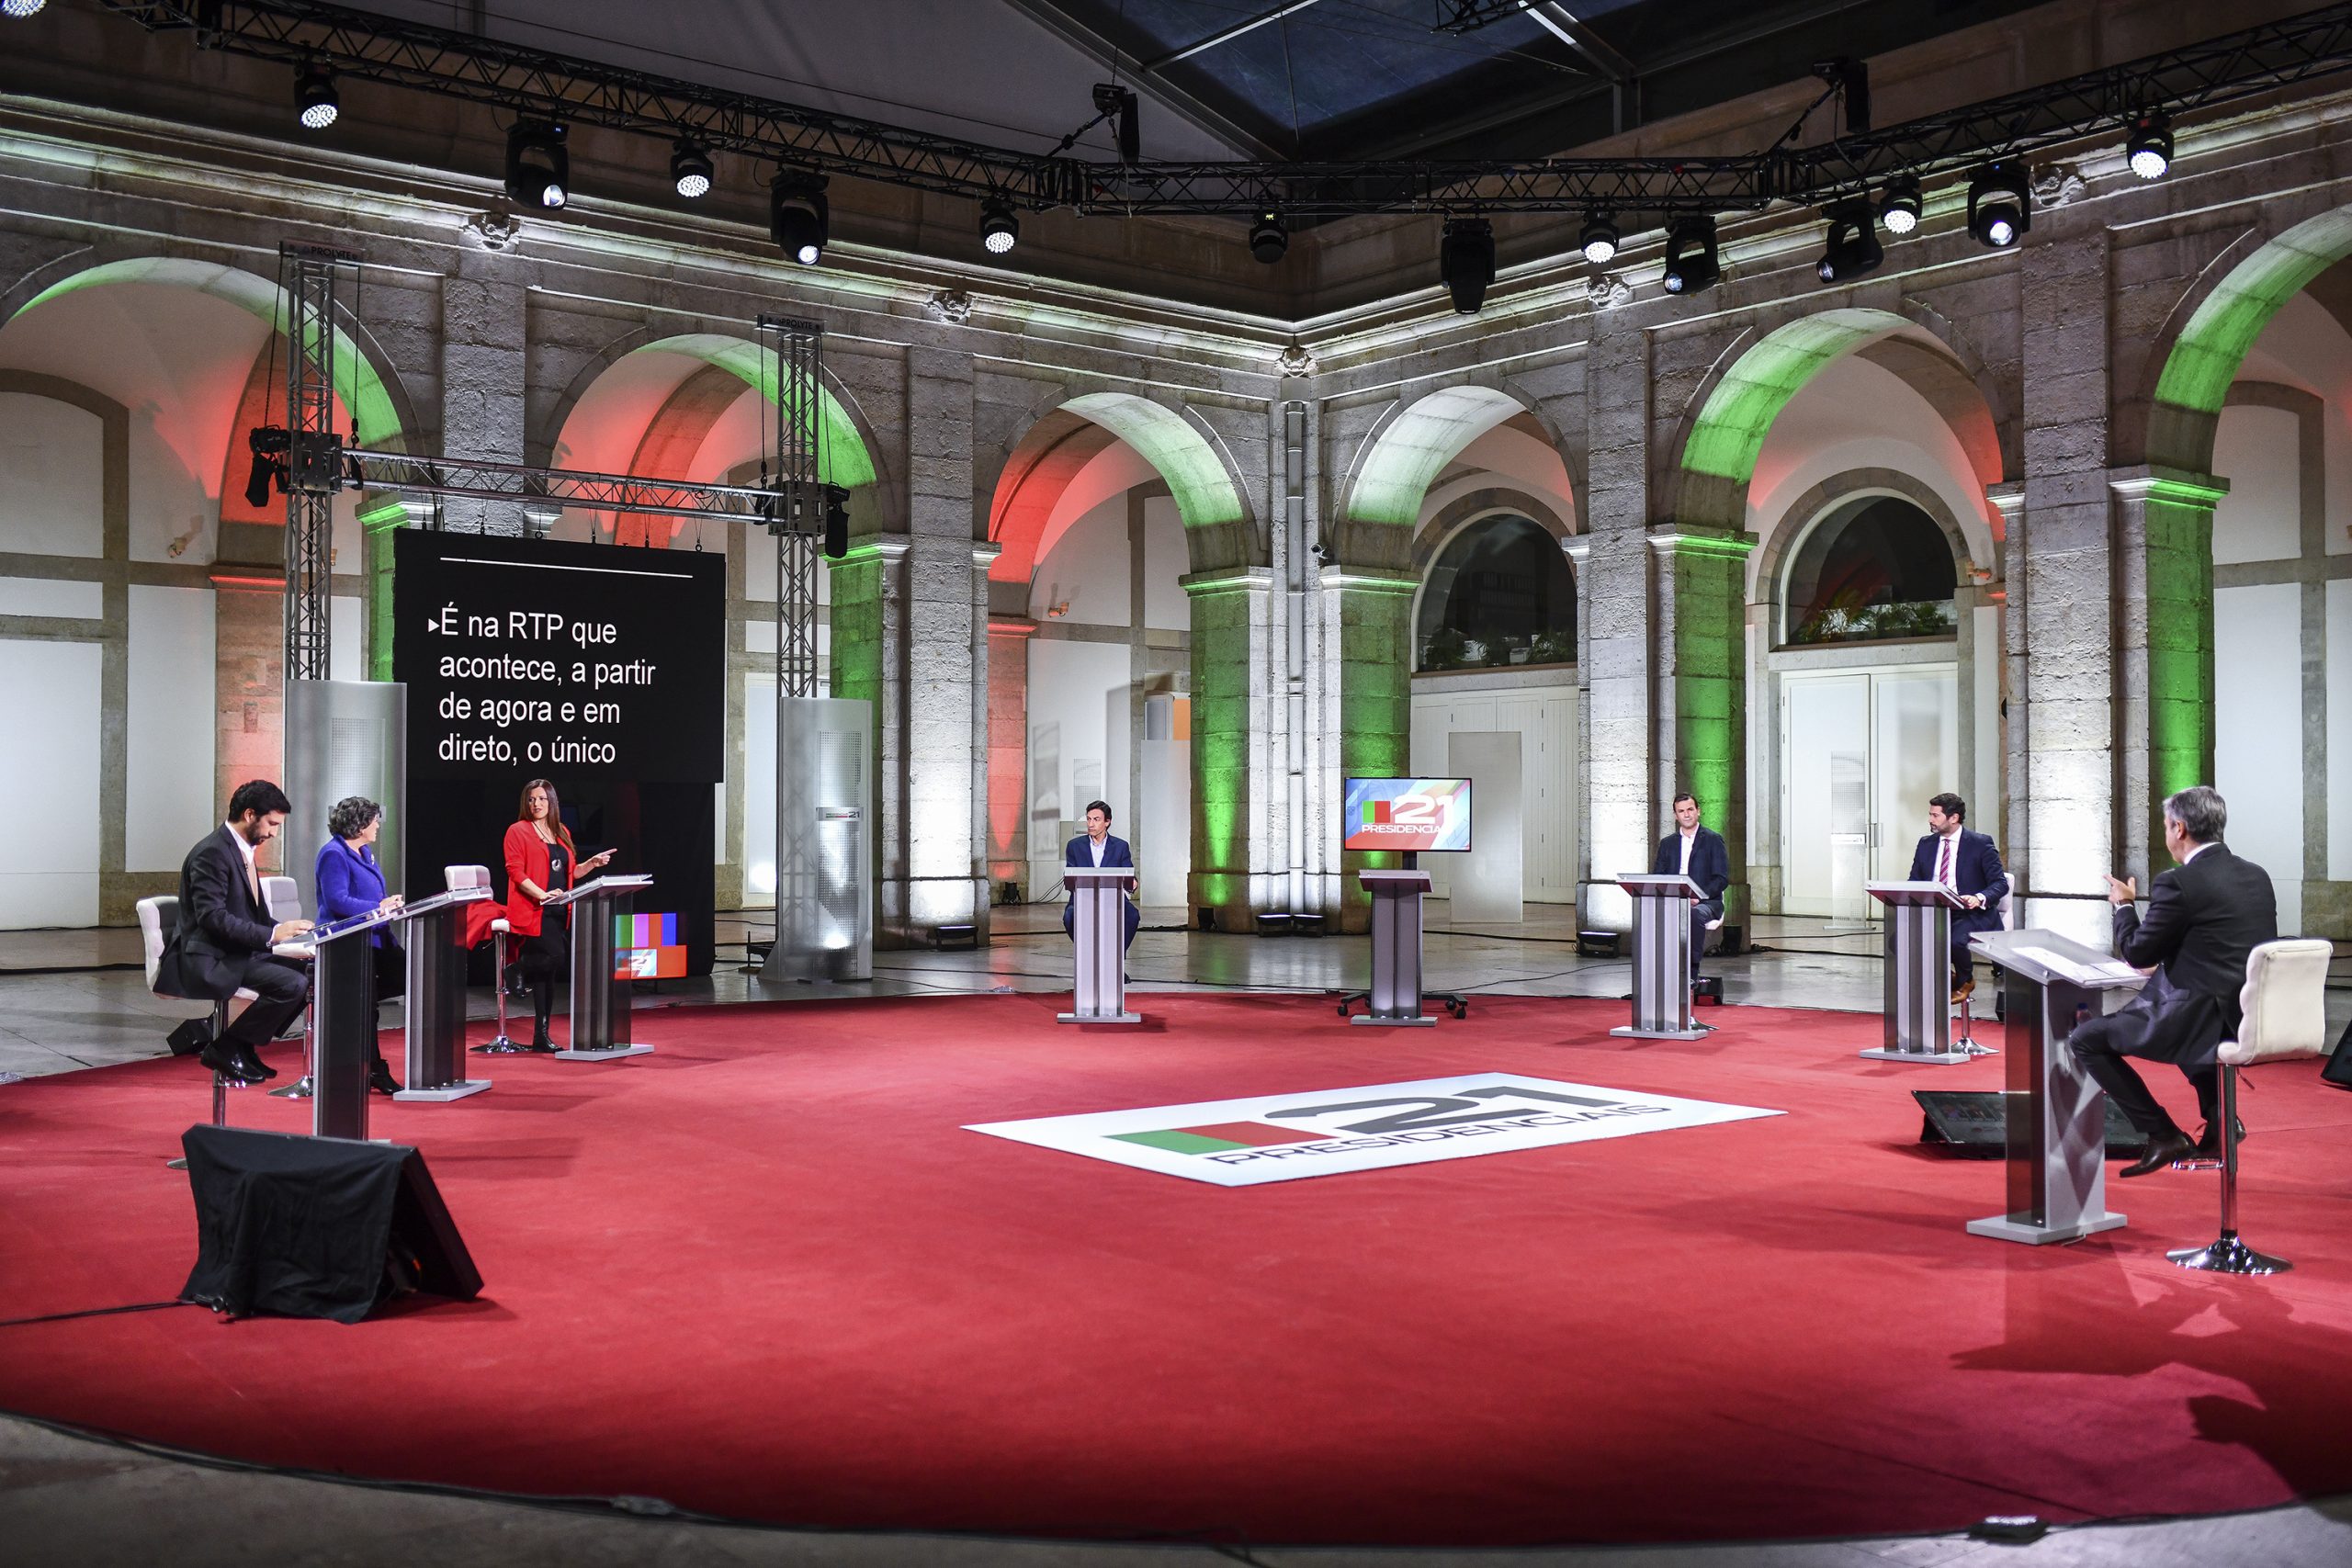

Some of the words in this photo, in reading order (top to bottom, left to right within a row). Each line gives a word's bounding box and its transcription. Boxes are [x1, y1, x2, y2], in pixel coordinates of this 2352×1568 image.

[311, 245, 351, 257] PROLYTE
[781, 318, 813, 330] PROLYTE
[441, 601, 459, 636] É
[468, 615, 500, 638] na
[509, 611, 564, 640] RTP
[571, 621, 617, 649] que
[439, 653, 562, 686] acontece,
[571, 661, 586, 682] a
[594, 659, 657, 691] partir
[438, 691, 471, 720] de
[480, 699, 552, 728] agora
[560, 702, 576, 723] e
[583, 703, 620, 724] em
[438, 732, 517, 766] direto,
[526, 741, 543, 762] o
[551, 735, 616, 763] único
[1393, 794, 1454, 825] 21
[1362, 824, 1453, 834] PRESIDENCIA
[1264, 1086, 1625, 1134] 21
[1204, 1104, 1672, 1165] PRESIDENCIAIS
